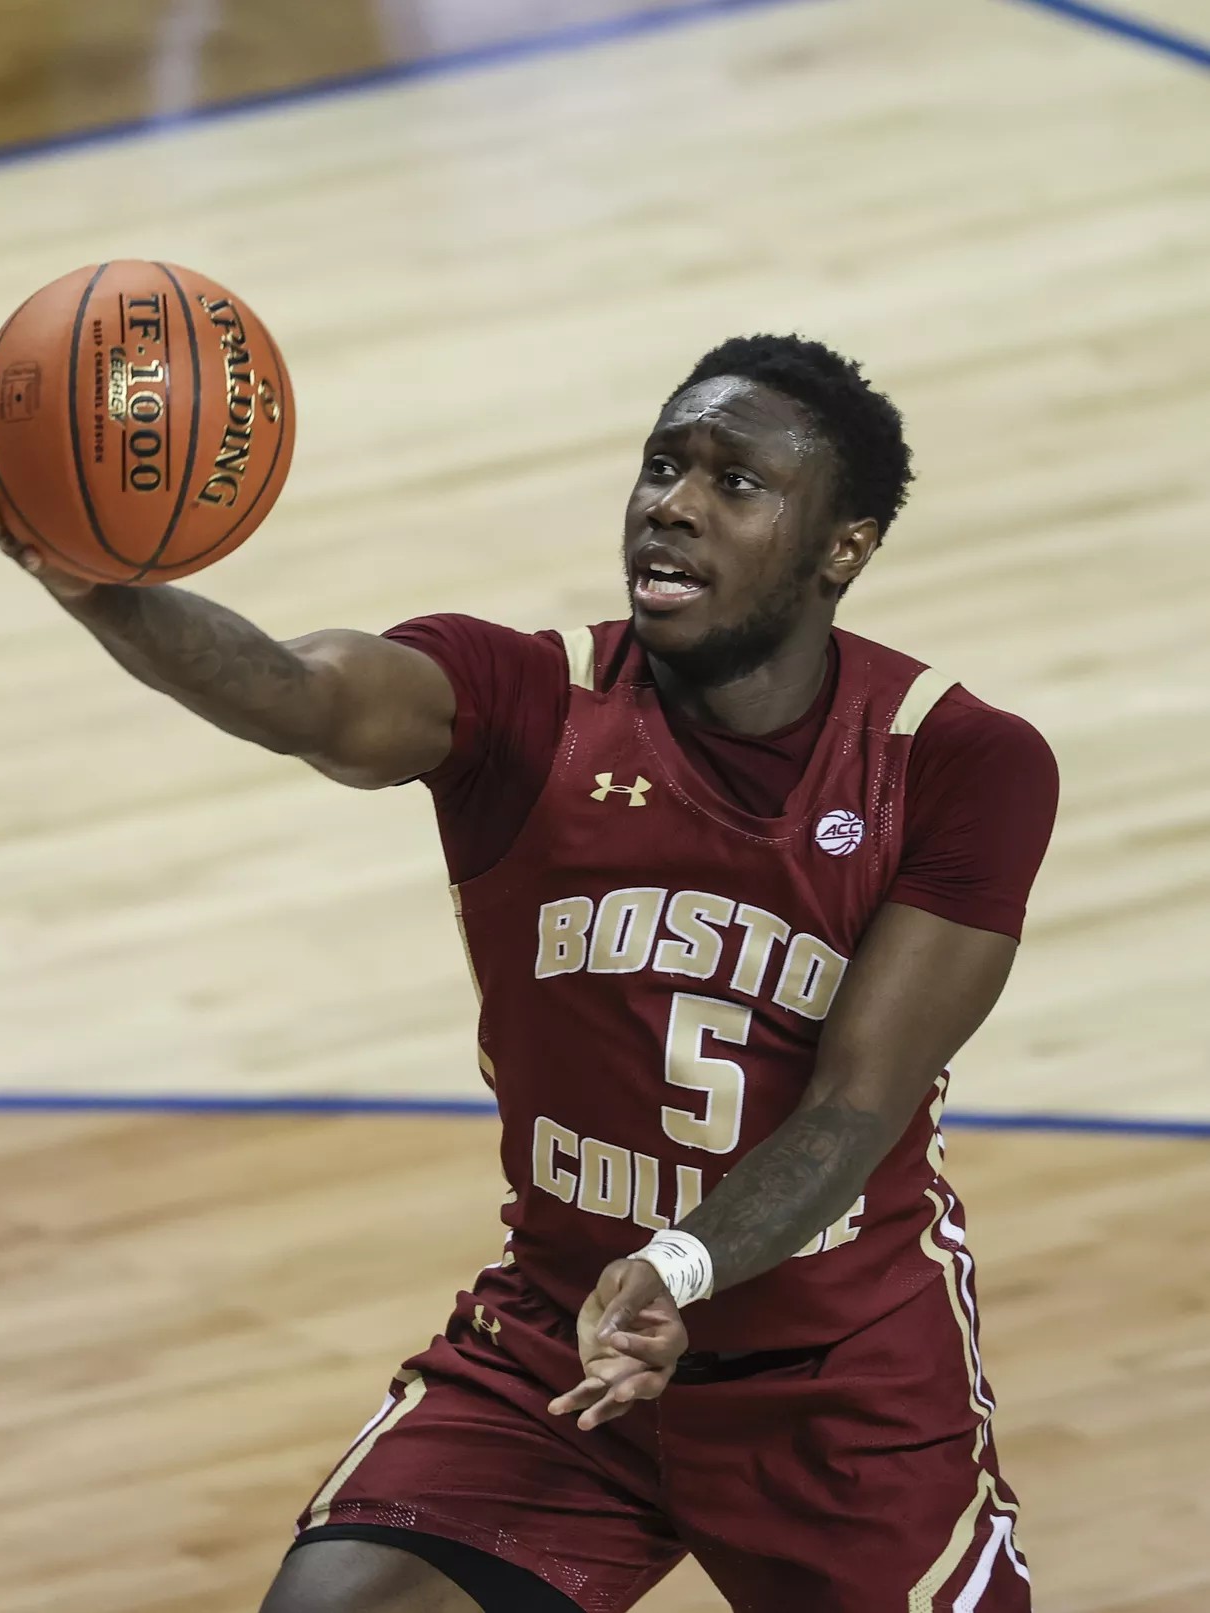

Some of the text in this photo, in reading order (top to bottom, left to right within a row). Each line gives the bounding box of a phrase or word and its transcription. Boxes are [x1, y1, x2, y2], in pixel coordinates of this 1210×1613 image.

[93, 319, 104, 464] DEEP CHANNEL DESIGN
[197, 294, 256, 509] SPALDING
[821, 821, 863, 837] ACC
[534, 886, 850, 1021] BOSTO
[661, 991, 754, 1154] 5
